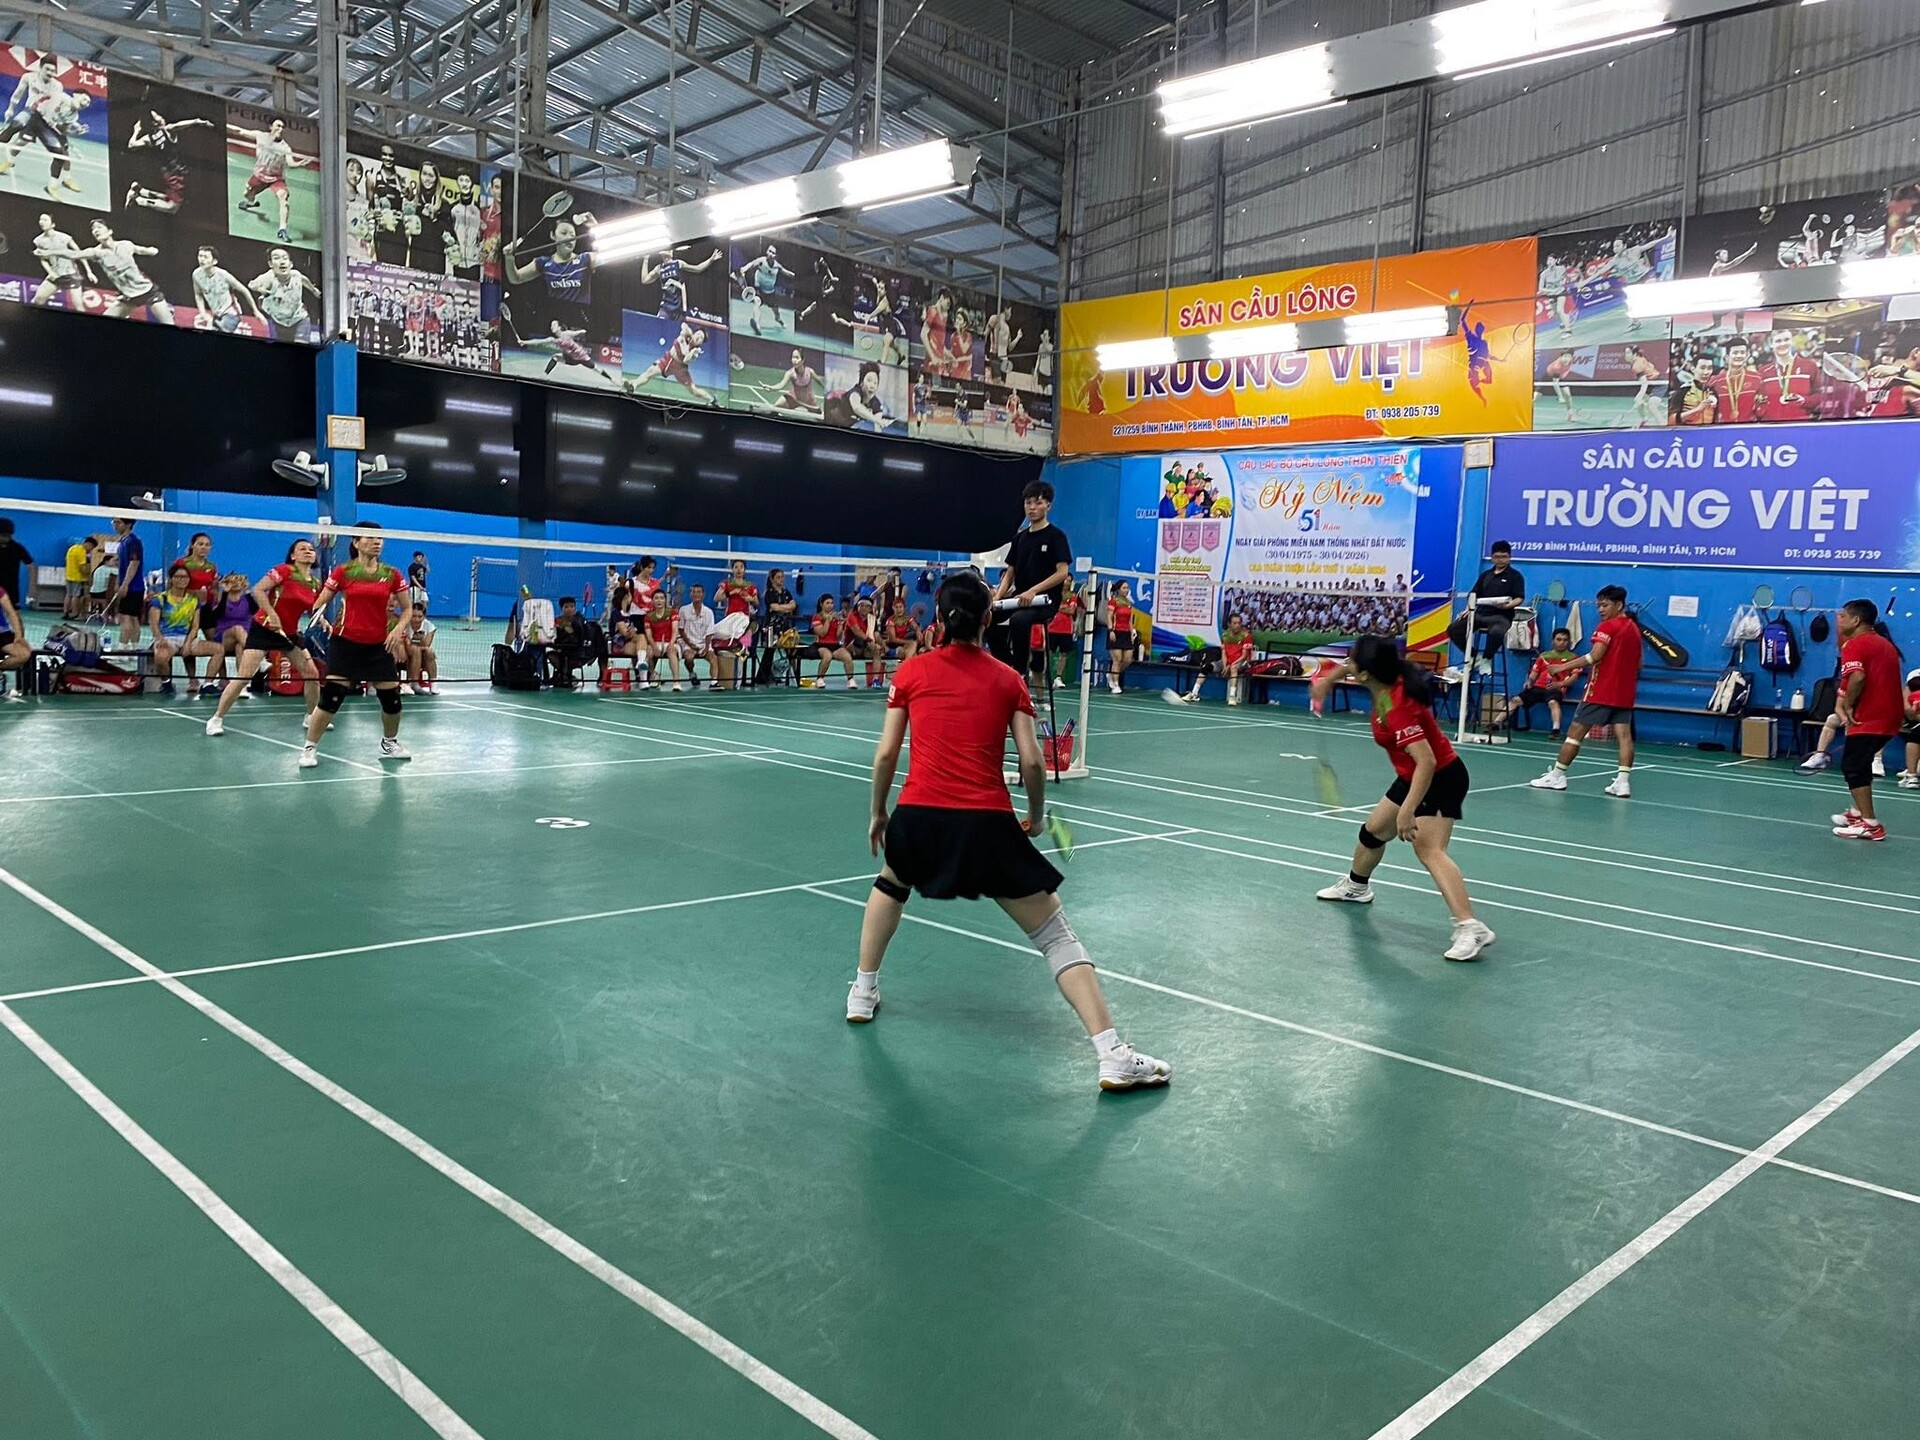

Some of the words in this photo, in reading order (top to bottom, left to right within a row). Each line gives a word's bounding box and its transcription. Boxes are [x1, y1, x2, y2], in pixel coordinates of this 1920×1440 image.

[1179, 300, 1222, 328] SÂN
[1230, 287, 1279, 322] CẦU
[1287, 284, 1357, 315] LÔNG
[1381, 407, 1401, 418] 0938
[1403, 406, 1420, 417] 205
[1422, 405, 1440, 416] 739
[1113, 424, 1140, 437] 221/259
[1257, 416, 1268, 427] TP.
[1270, 415, 1289, 426] HCM
[1583, 443, 1636, 470] SÂN
[1643, 437, 1704, 469] CẦU
[1713, 440, 1799, 469] LÔNG
[1522, 478, 1731, 530] TRƯỜNG
[1749, 476, 1870, 543] VIỆT
[1309, 538, 1326, 547] NAM
[1505, 541, 1543, 551] 21/259
[1545, 541, 1567, 551] BÌNH
[1568, 542, 1603, 554] THÀNH,
[1605, 544, 1641, 555] PBHHB,
[1643, 544, 1667, 555] BÌNH
[1669, 544, 1691, 556] TÂN,
[1694, 547, 1707, 556] TP.
[1710, 547, 1736, 556] HCM
[1803, 549, 1832, 559] 0938
[1834, 549, 1856, 559] 205
[1859, 549, 1881, 560] 739
